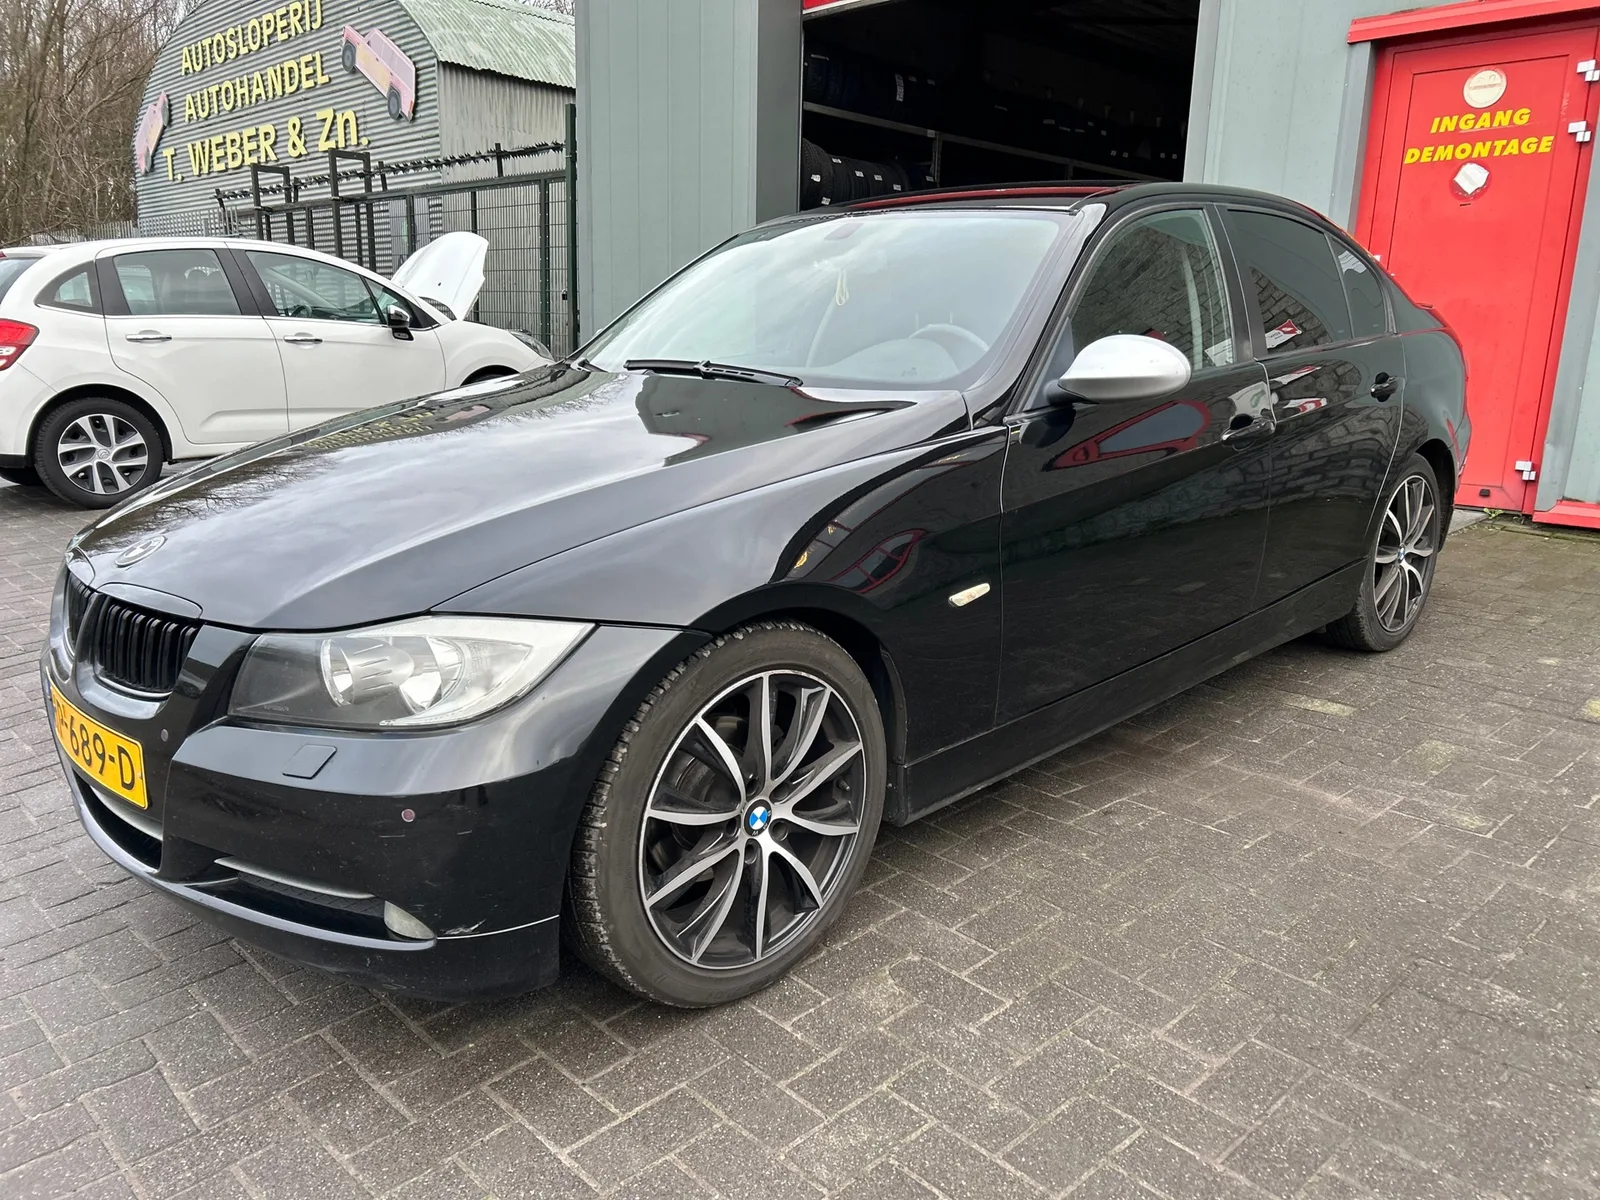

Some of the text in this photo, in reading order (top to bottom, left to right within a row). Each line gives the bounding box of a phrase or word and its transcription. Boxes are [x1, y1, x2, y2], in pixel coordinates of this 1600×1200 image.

[181, 0, 323, 76] AUTOSLOPERIJ
[184, 51, 329, 122] AUTOHANDEL
[1430, 108, 1531, 133] INGANG
[162, 108, 369, 181] T. WEBER & Zn.
[1404, 135, 1554, 164] DEMONTAGE
